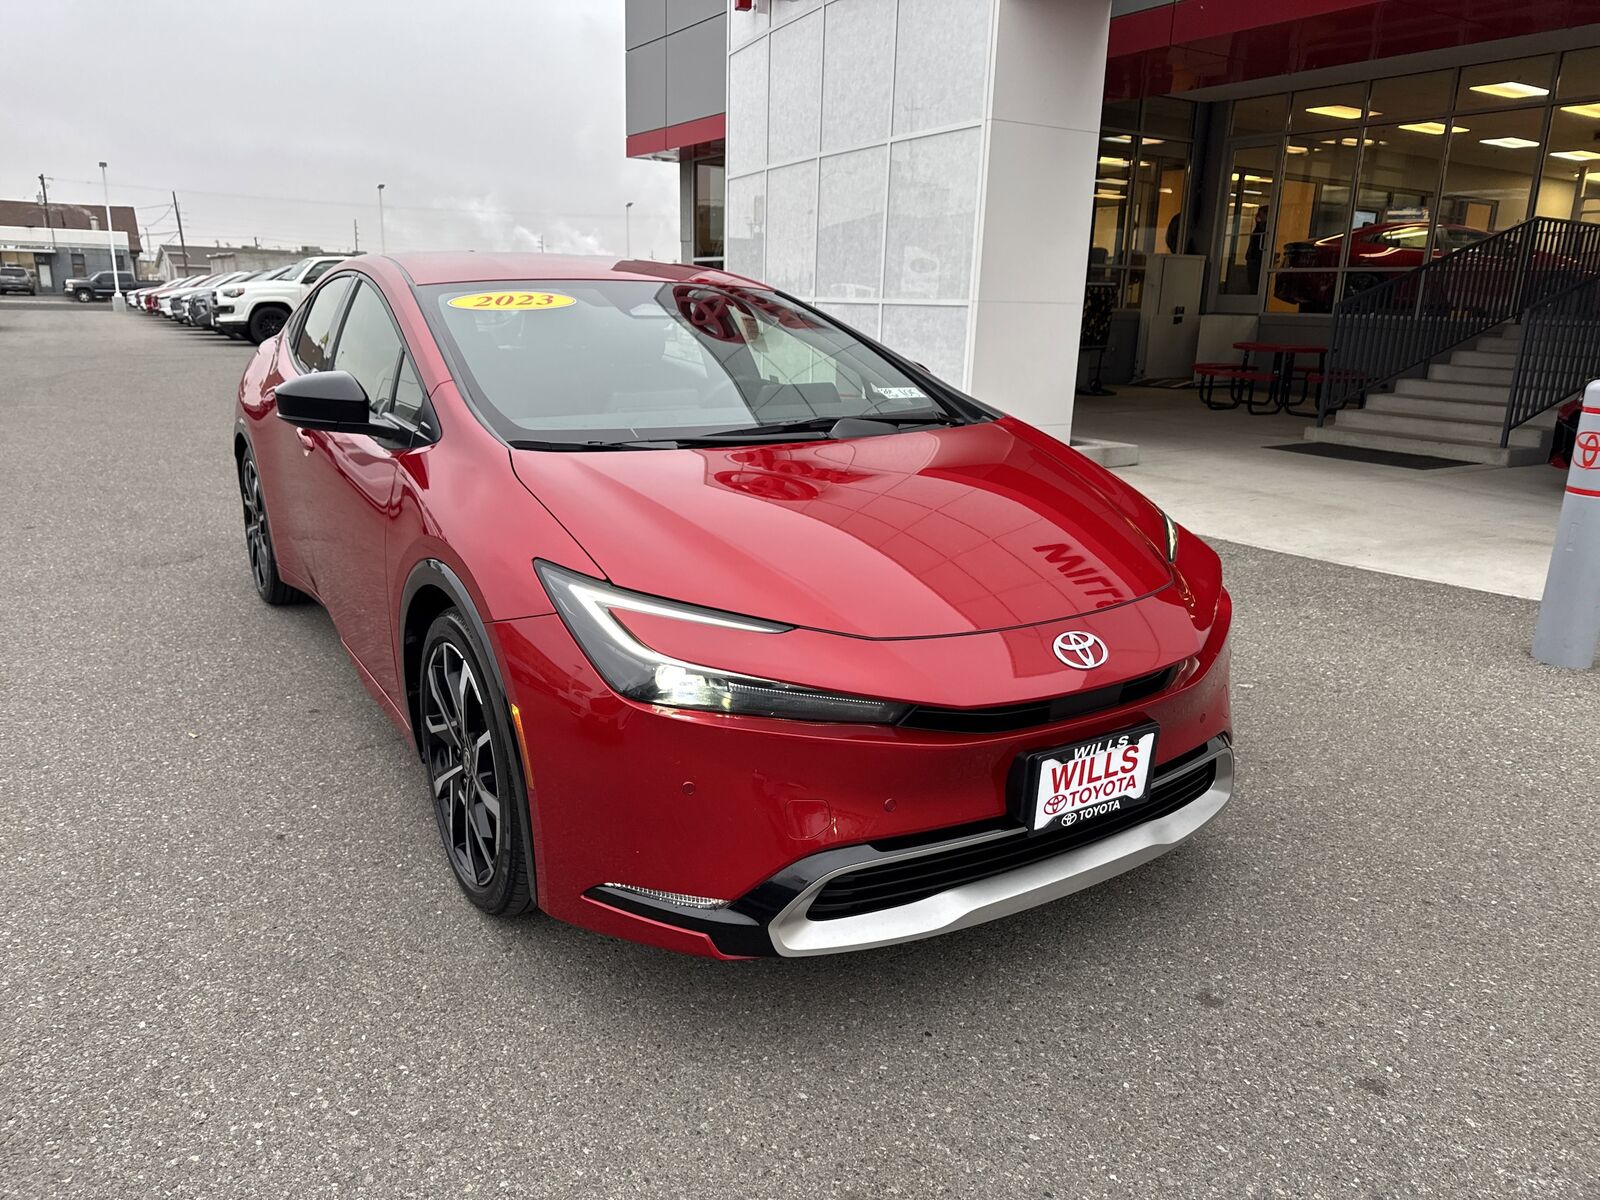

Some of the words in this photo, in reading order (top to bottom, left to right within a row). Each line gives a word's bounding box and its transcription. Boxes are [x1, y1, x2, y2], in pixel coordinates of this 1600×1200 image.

[474, 294, 554, 307] 2023
[1074, 735, 1129, 760] WILLS
[1051, 745, 1139, 794] WILLS
[1069, 775, 1137, 806] TOYOTA
[1079, 800, 1121, 820] TOYOTA
